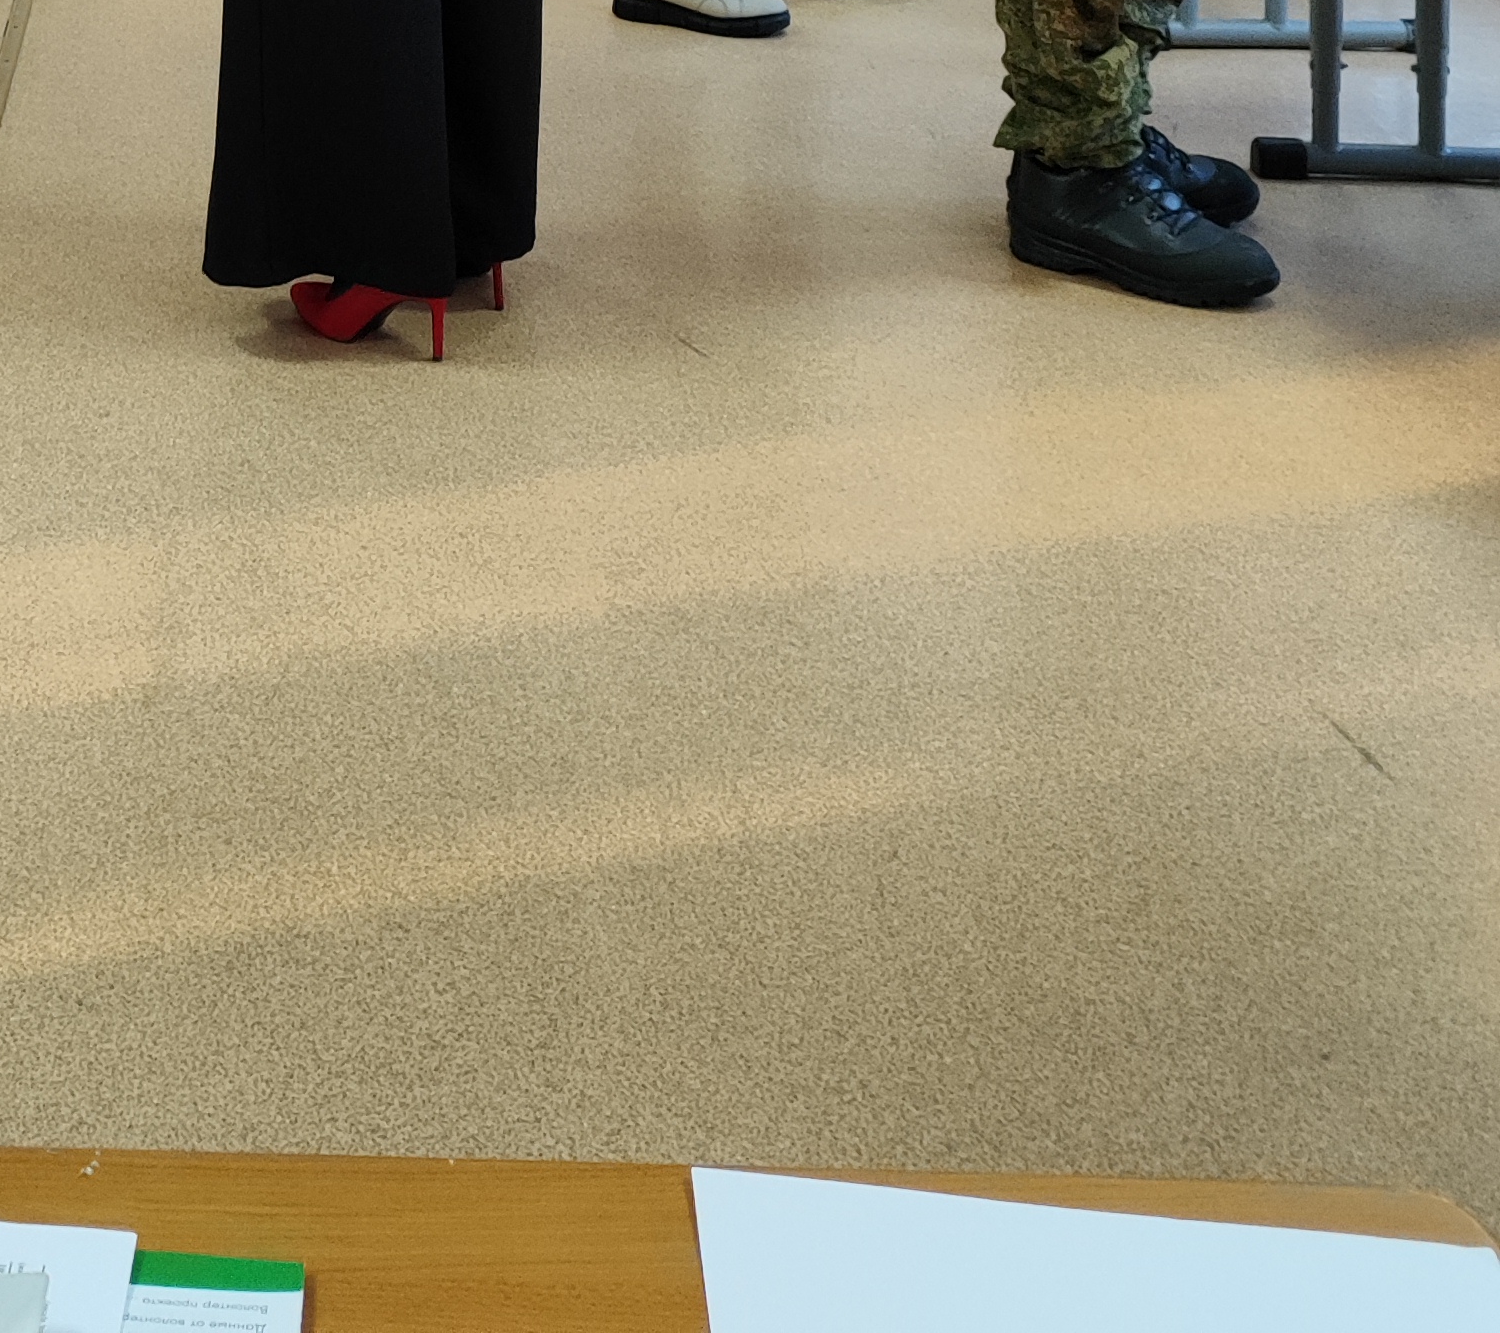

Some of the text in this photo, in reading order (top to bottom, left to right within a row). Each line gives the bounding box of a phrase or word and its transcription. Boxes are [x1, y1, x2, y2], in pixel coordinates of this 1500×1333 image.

[202, 1300, 269, 1315] Волонтер
[190, 1319, 205, 1328] от
[209, 1319, 267, 1333] Данные
